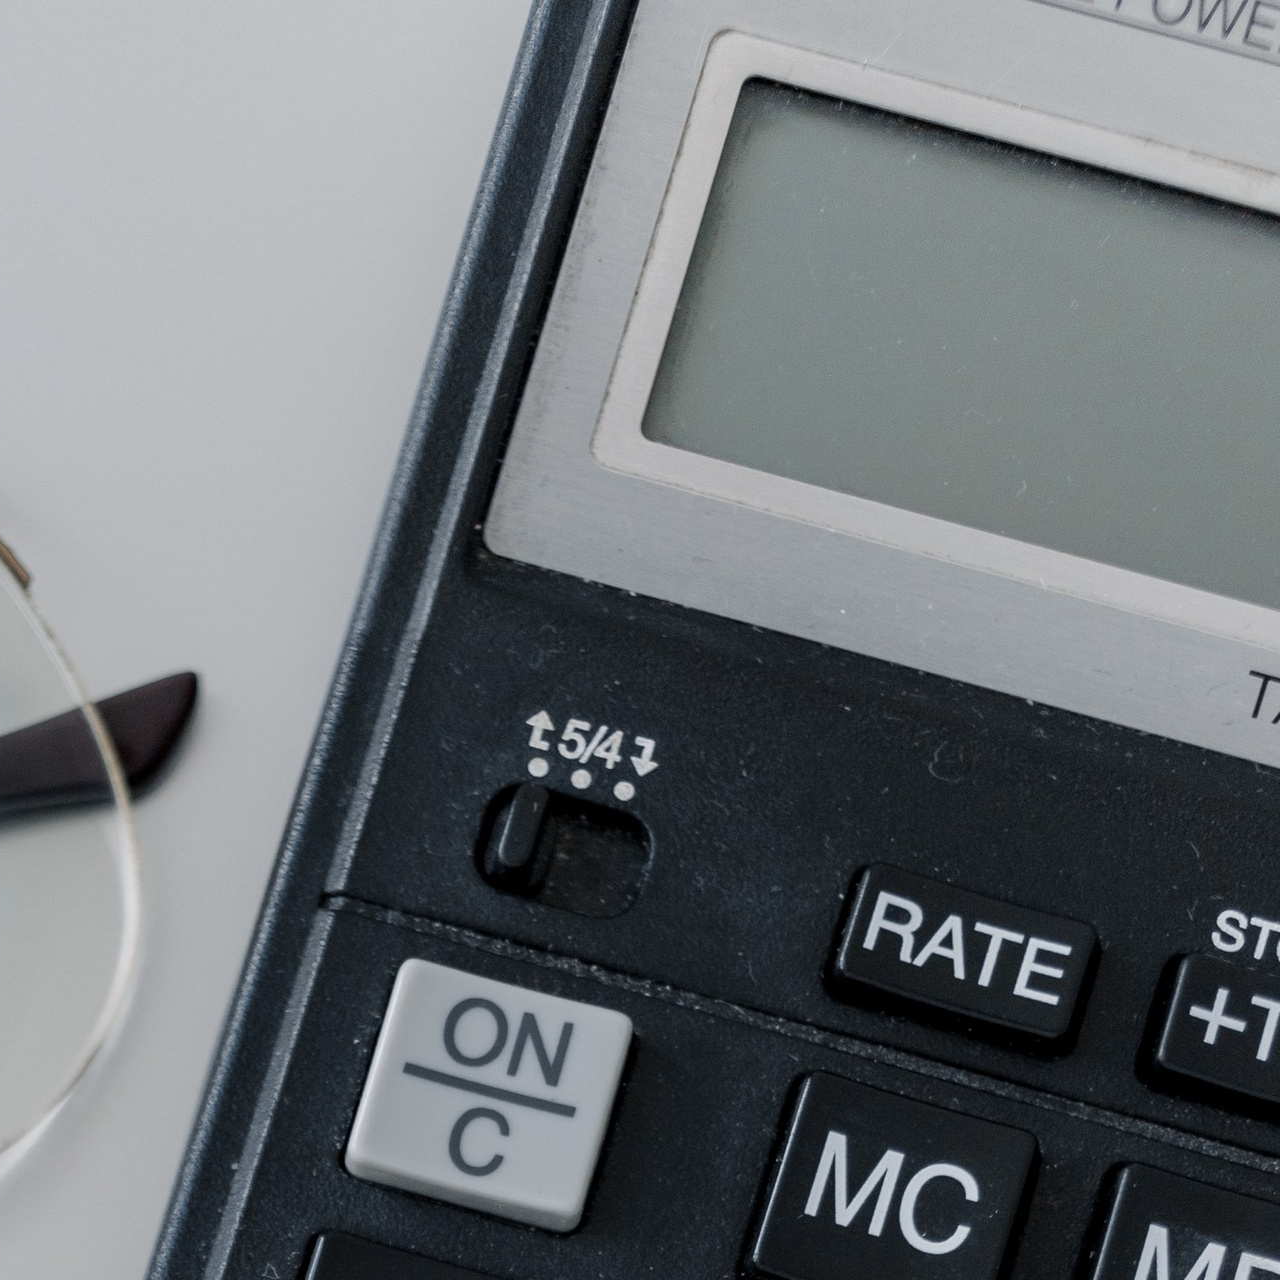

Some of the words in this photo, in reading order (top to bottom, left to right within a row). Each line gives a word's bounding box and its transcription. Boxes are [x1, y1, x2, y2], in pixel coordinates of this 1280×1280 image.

[1114, 0, 1280, 54] OWE
[1249, 670, 1280, 724] T
[863, 891, 1071, 1005] RATE
[1212, 910, 1280, 959] ST
[443, 997, 574, 1088] ON
[449, 1107, 510, 1176] C
[805, 1131, 979, 1254] MC
